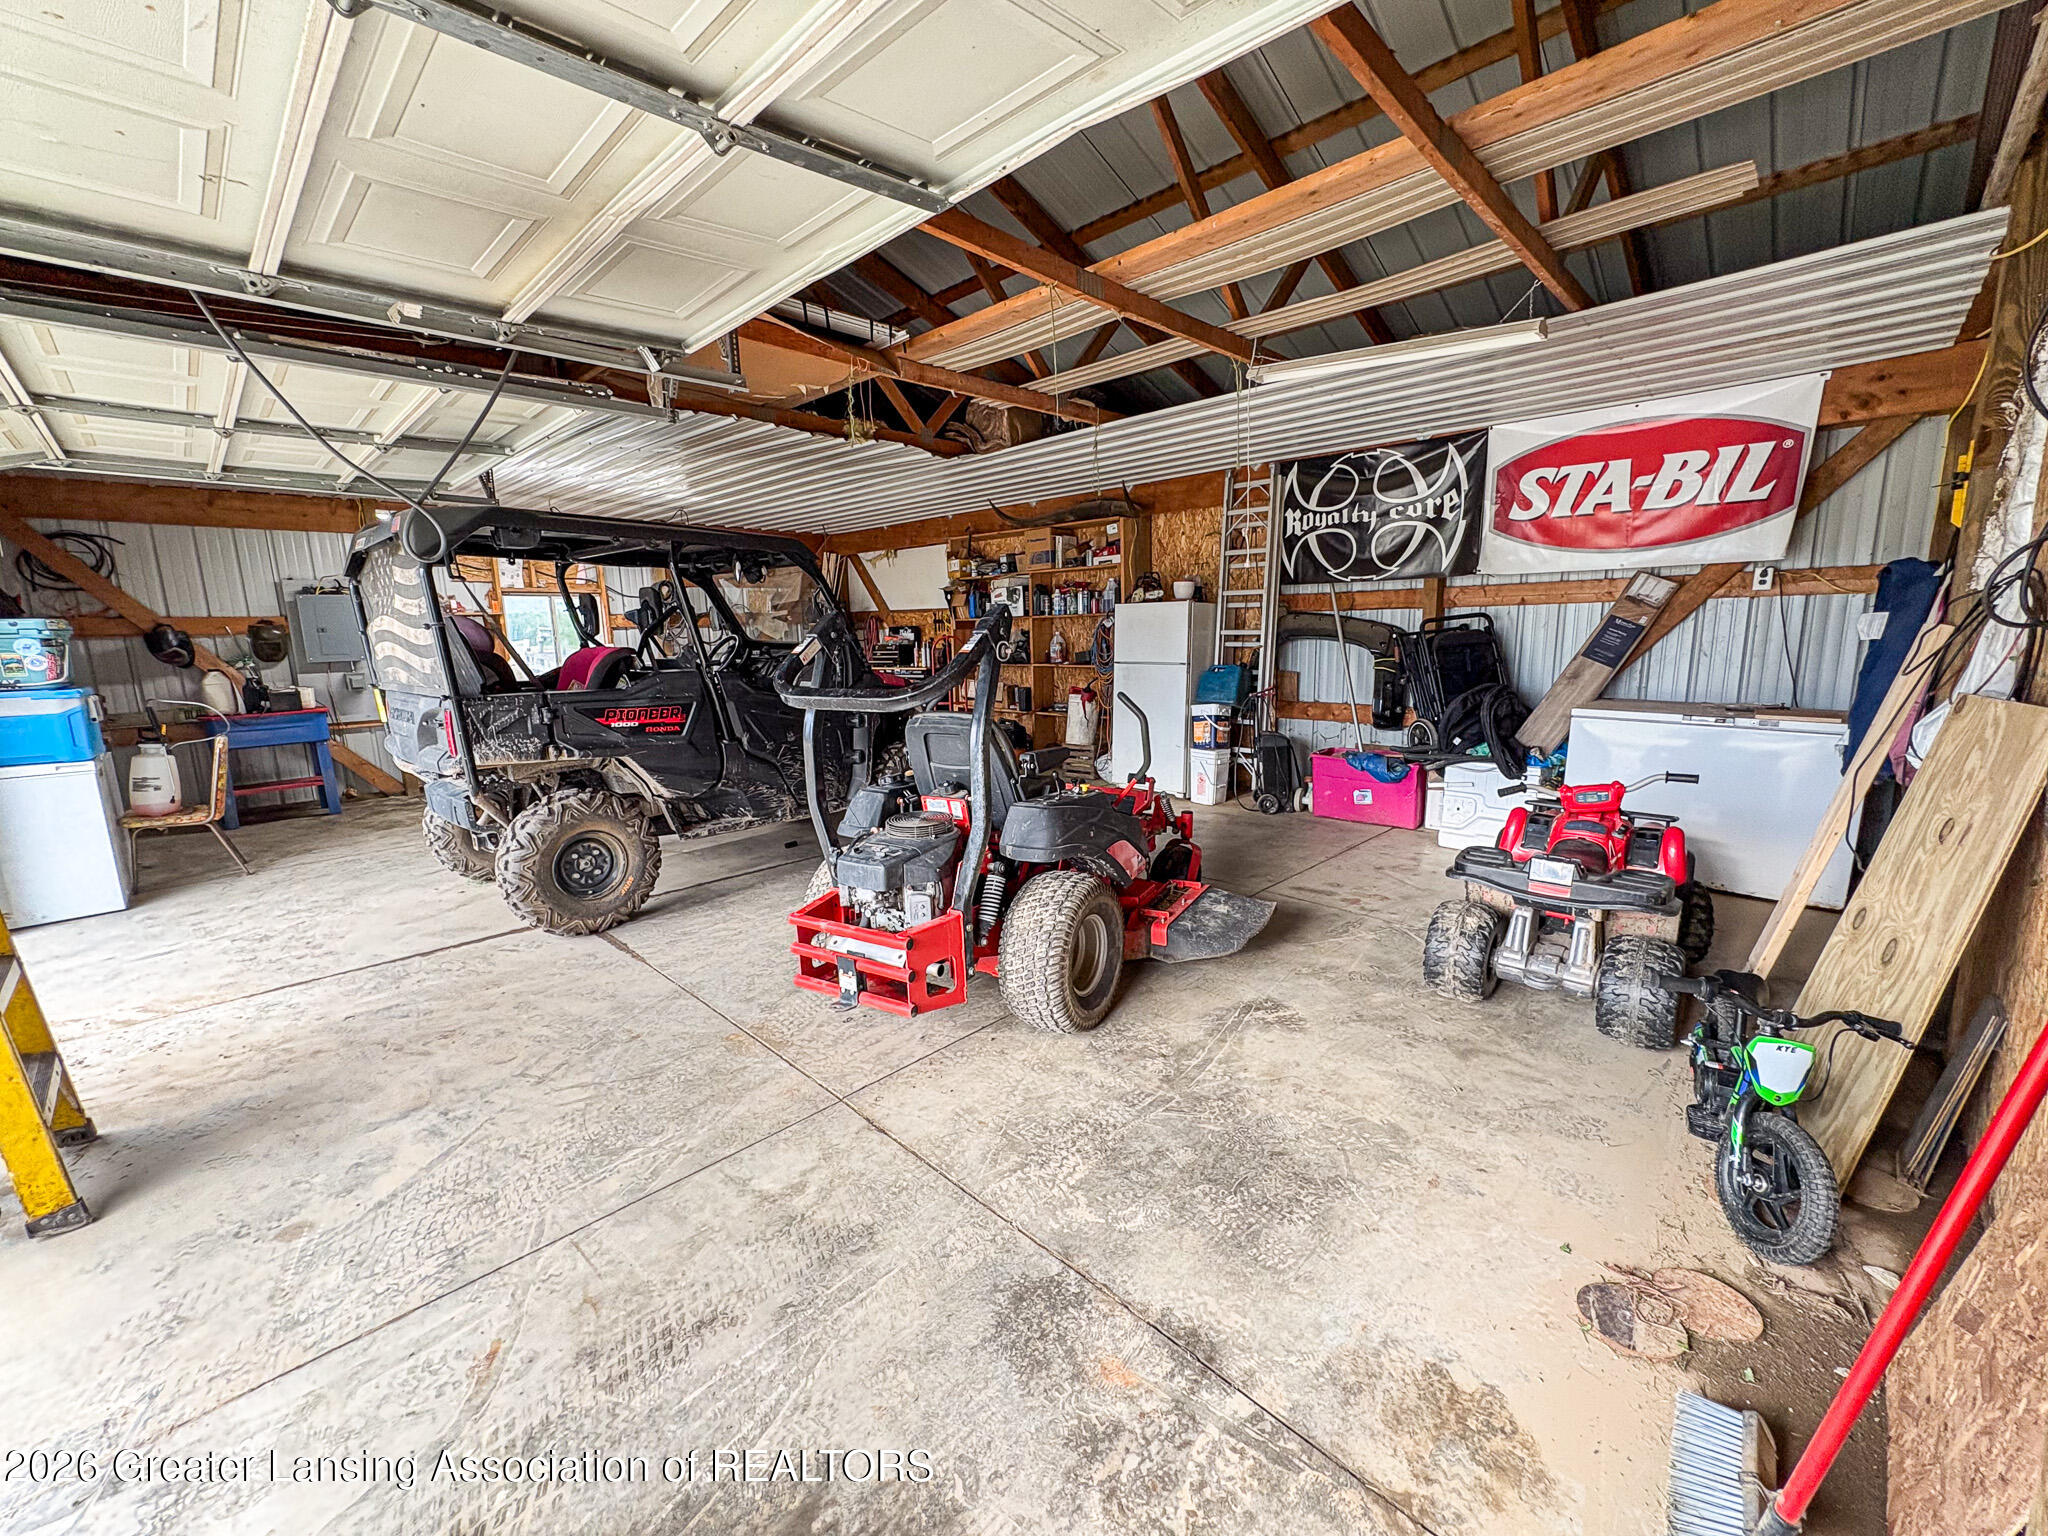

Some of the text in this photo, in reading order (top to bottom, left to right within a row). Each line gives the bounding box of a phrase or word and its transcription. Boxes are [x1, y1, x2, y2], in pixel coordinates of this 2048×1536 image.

[1508, 440, 1777, 521] STA-BIL
[1284, 488, 1461, 538] Royalty core
[604, 706, 683, 722] PIONEER
[645, 725, 681, 733] HONDA
